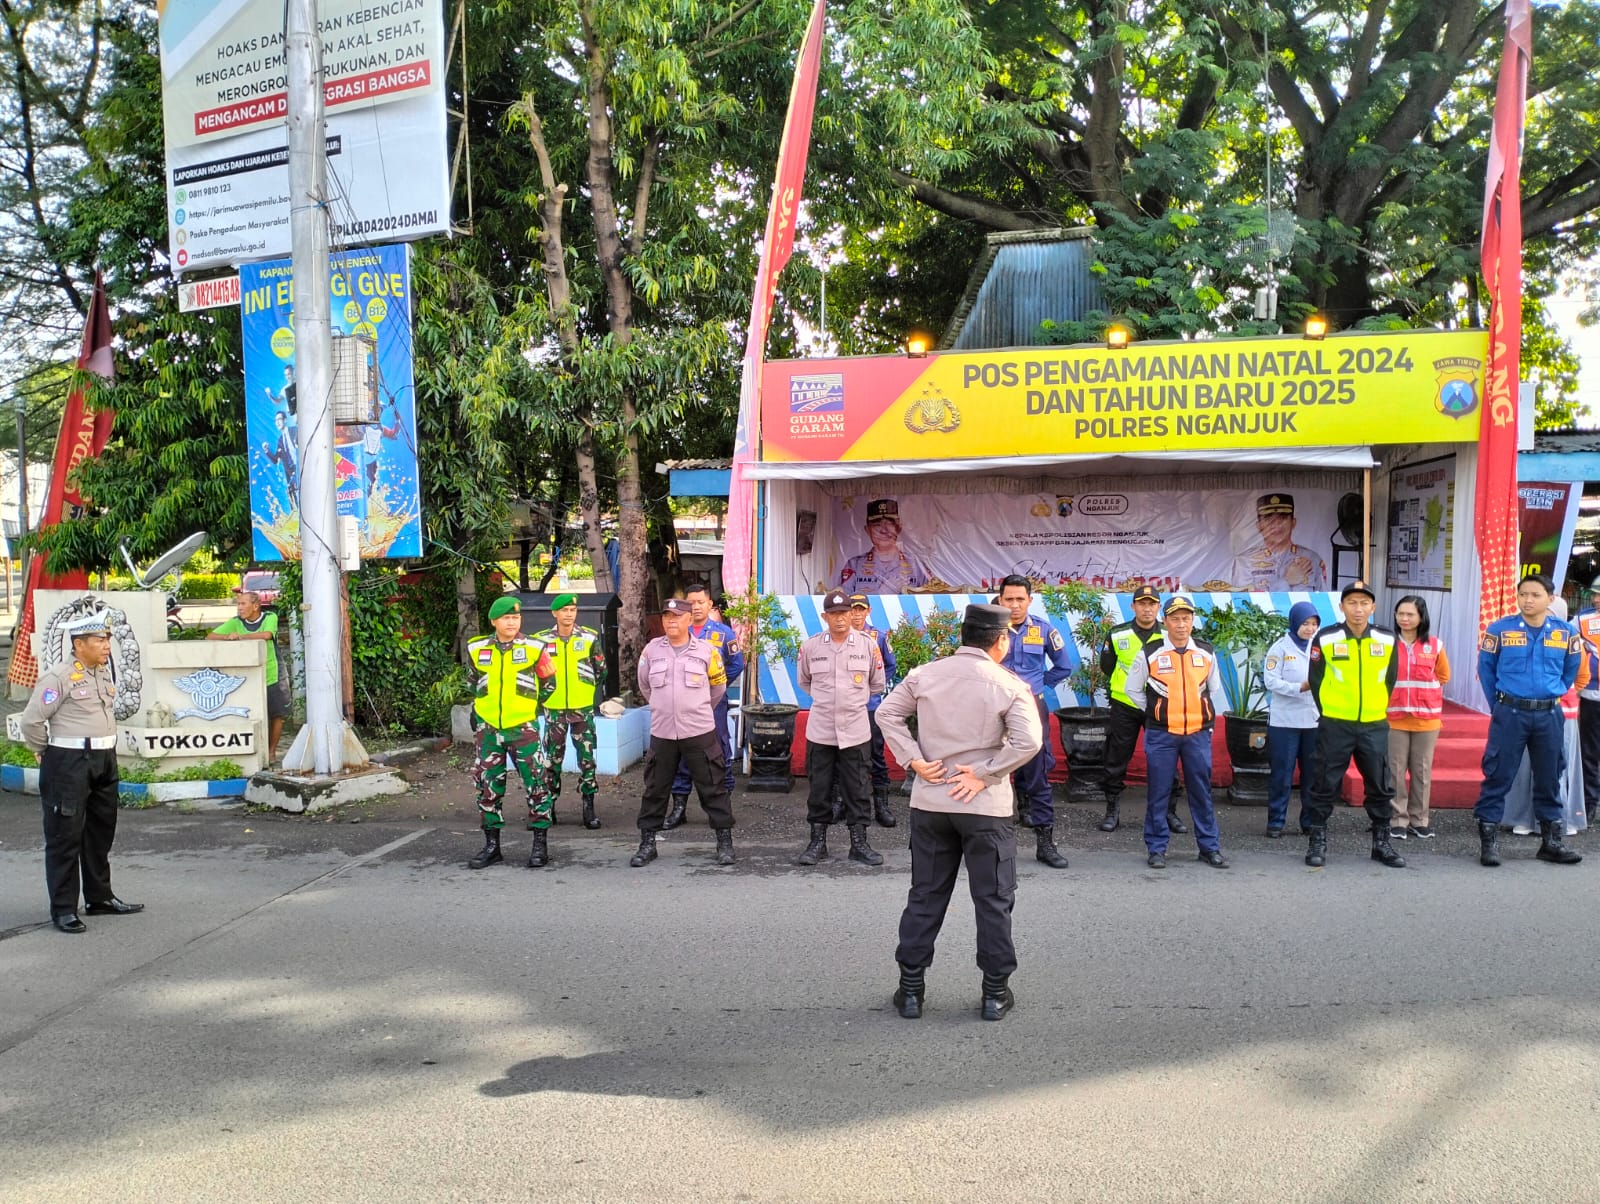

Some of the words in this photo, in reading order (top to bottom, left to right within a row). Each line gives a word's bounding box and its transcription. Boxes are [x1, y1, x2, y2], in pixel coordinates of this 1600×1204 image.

[217, 40, 258, 60] HOAKS
[261, 32, 287, 49] DAN
[346, 0, 424, 27] KEBENCIAN
[196, 57, 261, 87] MENGACAU
[337, 34, 372, 53] AKAL
[376, 20, 425, 42] SEHAT,
[395, 43, 425, 61] DAN
[198, 103, 275, 129] MENGANCAM
[369, 67, 427, 91] BANGSA
[174, 168, 207, 181] LAPORKAN
[207, 164, 229, 175] HOAKS
[231, 159, 244, 170] DAN
[245, 154, 270, 167] UJARAN
[220, 183, 231, 193] 123
[190, 230, 208, 239] Posko
[209, 223, 246, 236] Pengaduan
[248, 216, 289, 230] Masyarakat
[346, 255, 382, 269] ENERGI
[245, 285, 271, 315] INI
[358, 272, 404, 298] GUE
[370, 306, 385, 316] B12
[963, 362, 1019, 388] POS
[1024, 353, 1231, 386] PENGAMANAN
[1238, 350, 1331, 379] NATAL
[1337, 347, 1414, 374] 2024
[1457, 358, 1479, 368] TIMUR
[1026, 389, 1084, 415] DAN
[1089, 384, 1188, 412] TAHUN
[1195, 380, 1275, 409] BARU
[1280, 379, 1356, 406] 2025
[790, 414, 844, 424] GUDANG
[790, 423, 844, 433] GARAM
[1075, 416, 1168, 439] POLRES
[1176, 412, 1297, 436] NGANJUK
[145, 734, 207, 750] TOKO
[212, 732, 254, 748] CAT
